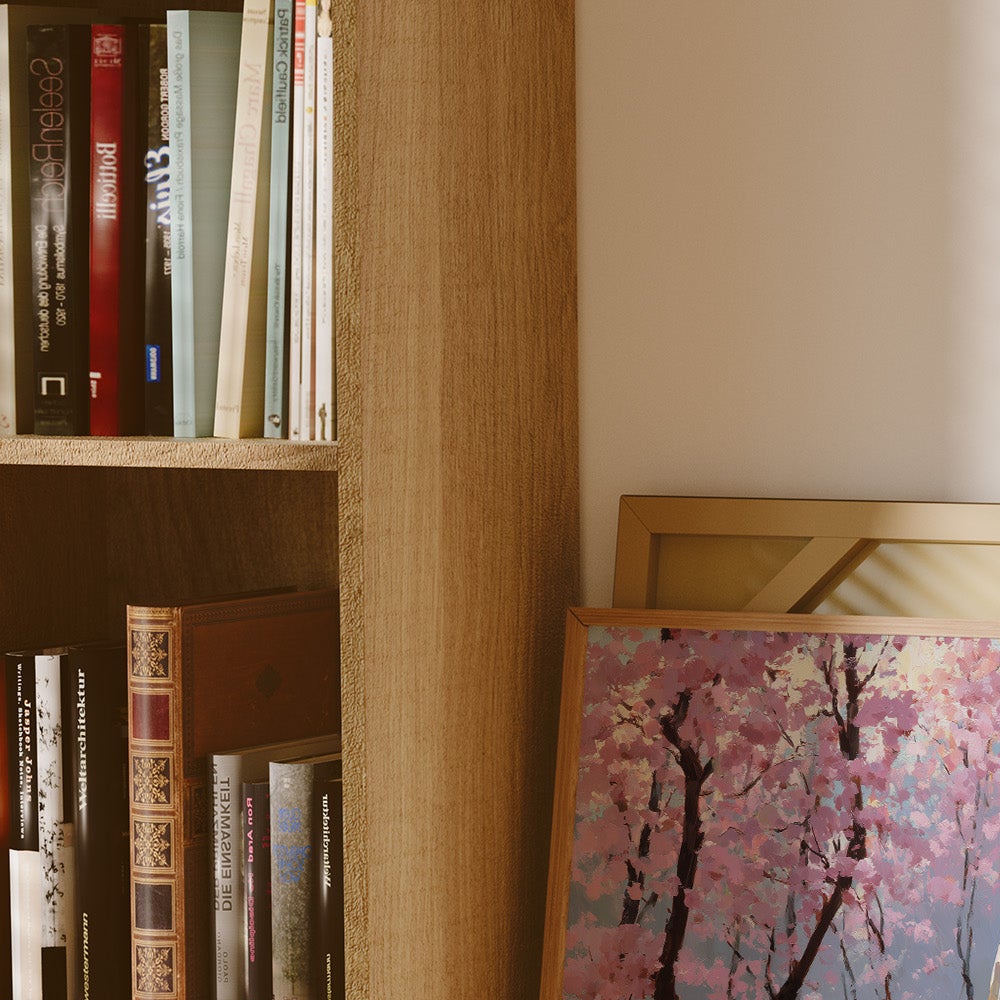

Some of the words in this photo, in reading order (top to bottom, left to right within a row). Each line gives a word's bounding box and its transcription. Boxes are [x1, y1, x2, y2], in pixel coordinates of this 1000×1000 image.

[24, 699, 33, 752] Jasper
[76, 668, 88, 811] Weltarchitektur
[25, 757, 33, 802] Johns
